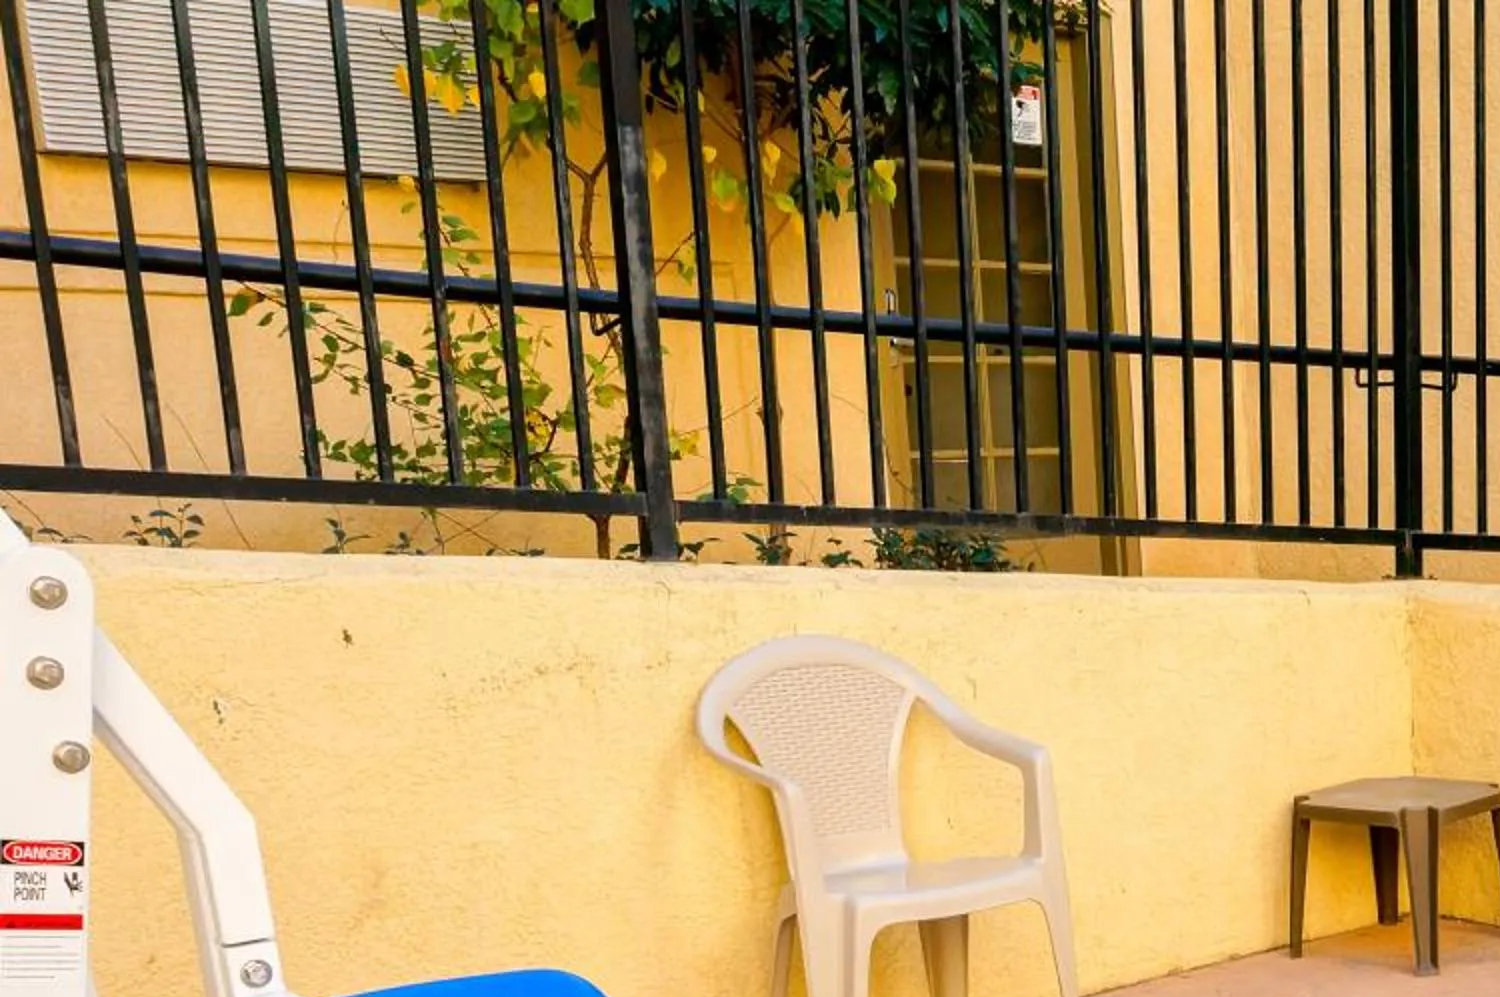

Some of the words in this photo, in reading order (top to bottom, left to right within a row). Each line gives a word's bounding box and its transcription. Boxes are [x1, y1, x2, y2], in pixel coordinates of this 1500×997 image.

[13, 845, 72, 860] DANGER
[14, 871, 47, 885] PINCH
[14, 887, 47, 901] POINT
